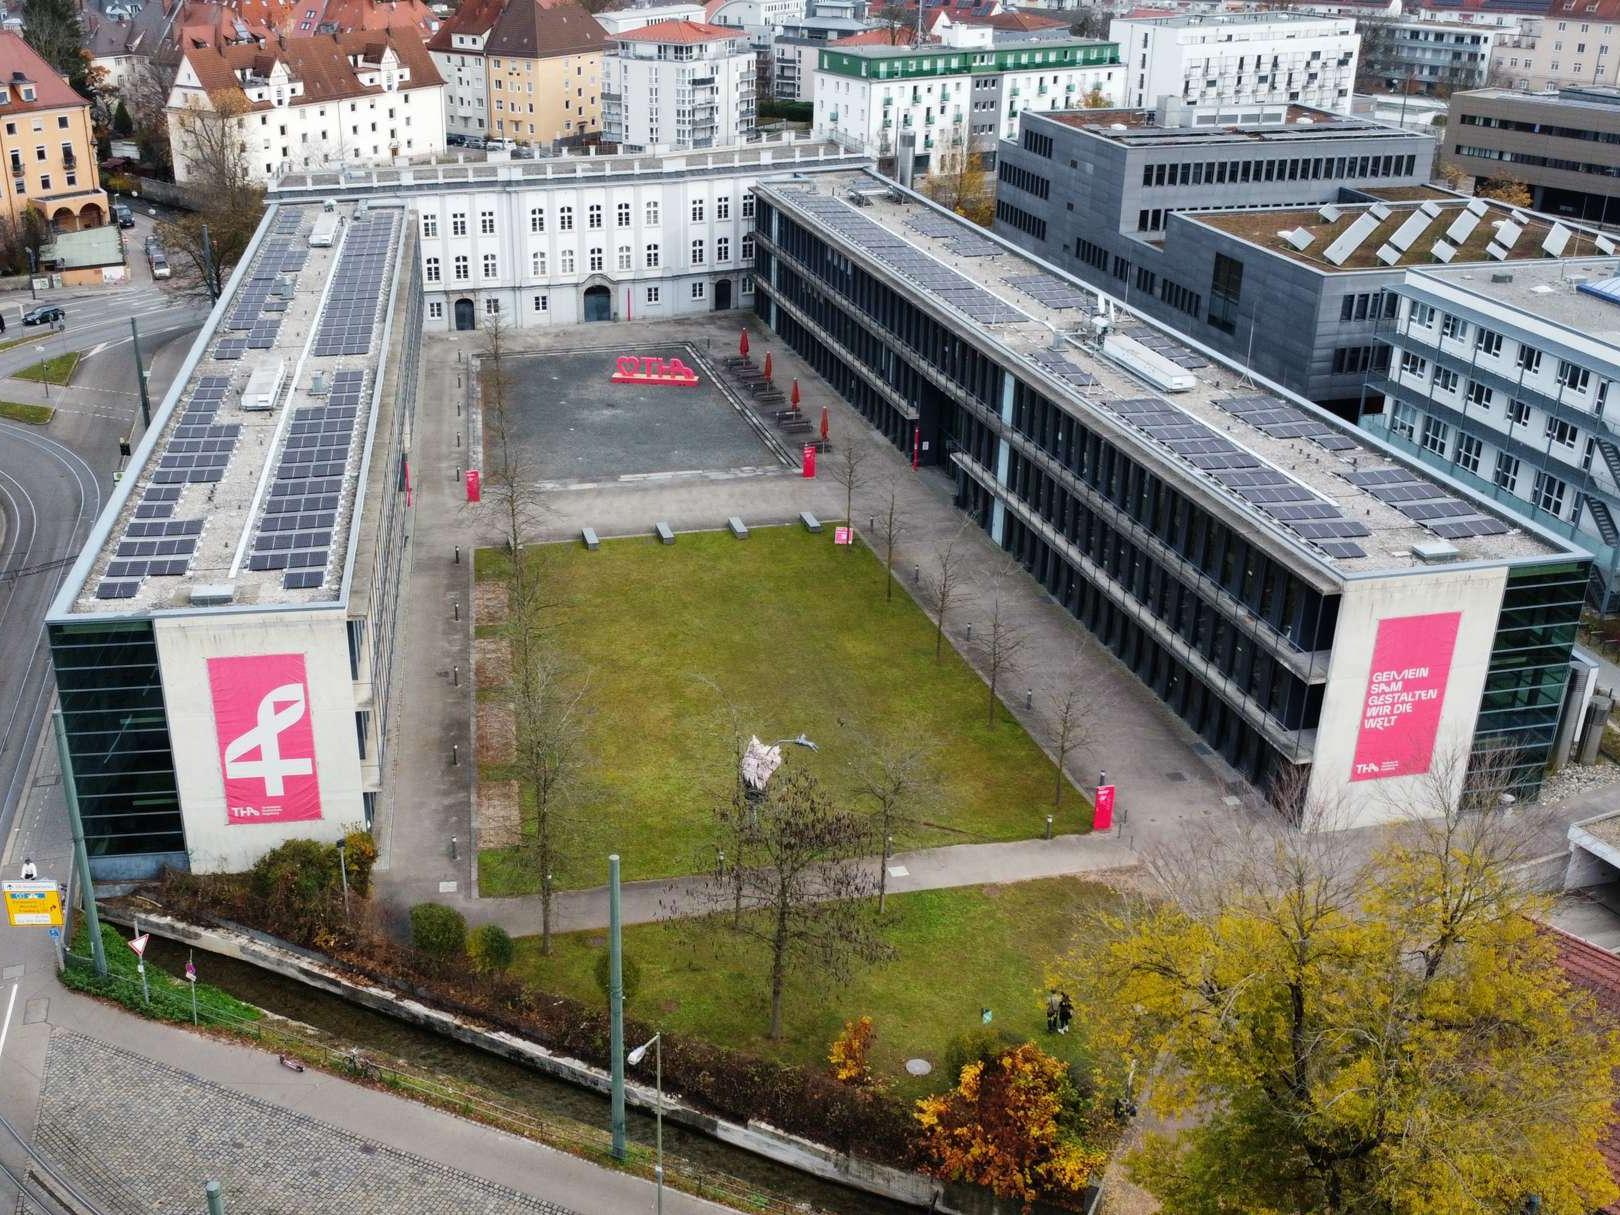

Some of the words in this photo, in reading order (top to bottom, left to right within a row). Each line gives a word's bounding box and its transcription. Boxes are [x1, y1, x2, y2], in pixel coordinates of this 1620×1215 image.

[1372, 667, 1429, 683] GEMEIN
[1370, 681, 1402, 694] SAM
[1368, 689, 1437, 705] GESTALTEN
[1366, 705, 1391, 717] WIR
[1393, 703, 1413, 714] DIE
[1364, 716, 1397, 730] WELT
